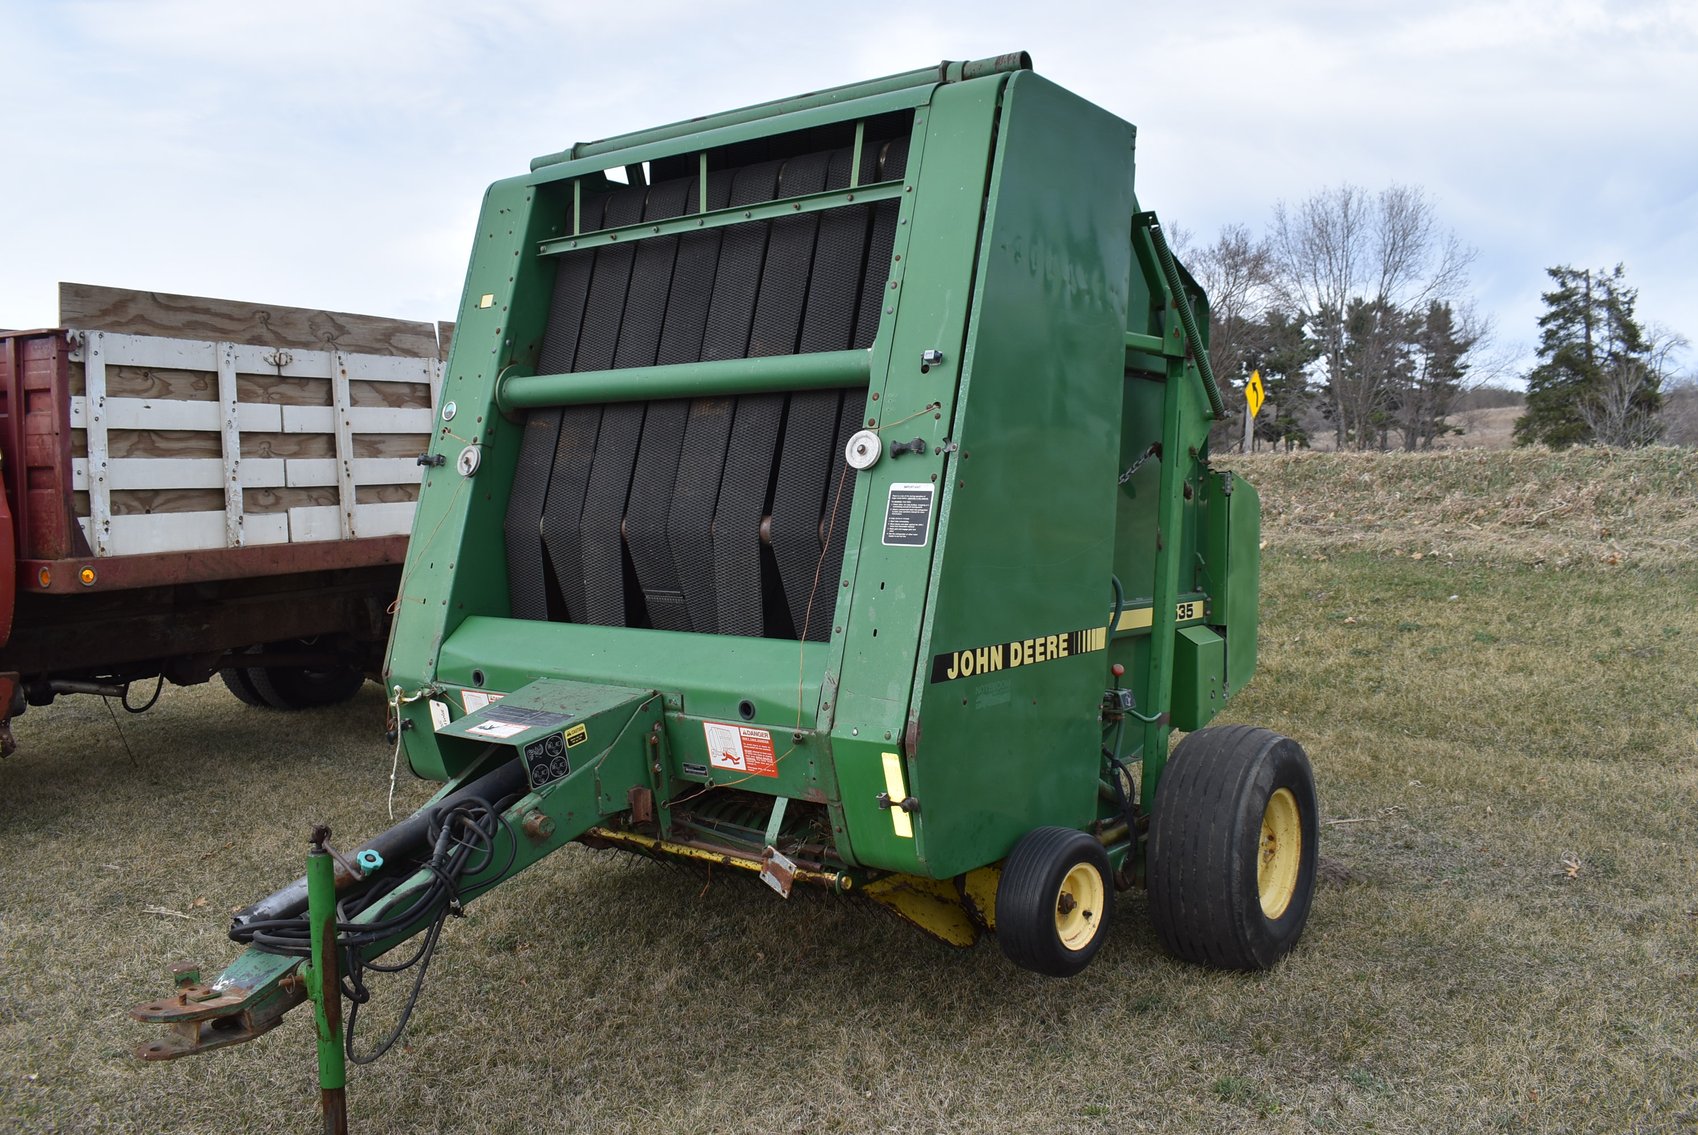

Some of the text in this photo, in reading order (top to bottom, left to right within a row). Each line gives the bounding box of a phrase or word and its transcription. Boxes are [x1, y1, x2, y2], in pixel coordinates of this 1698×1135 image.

[947, 633, 1069, 680] JOHN DEERE
[747, 730, 769, 738] DANGER
